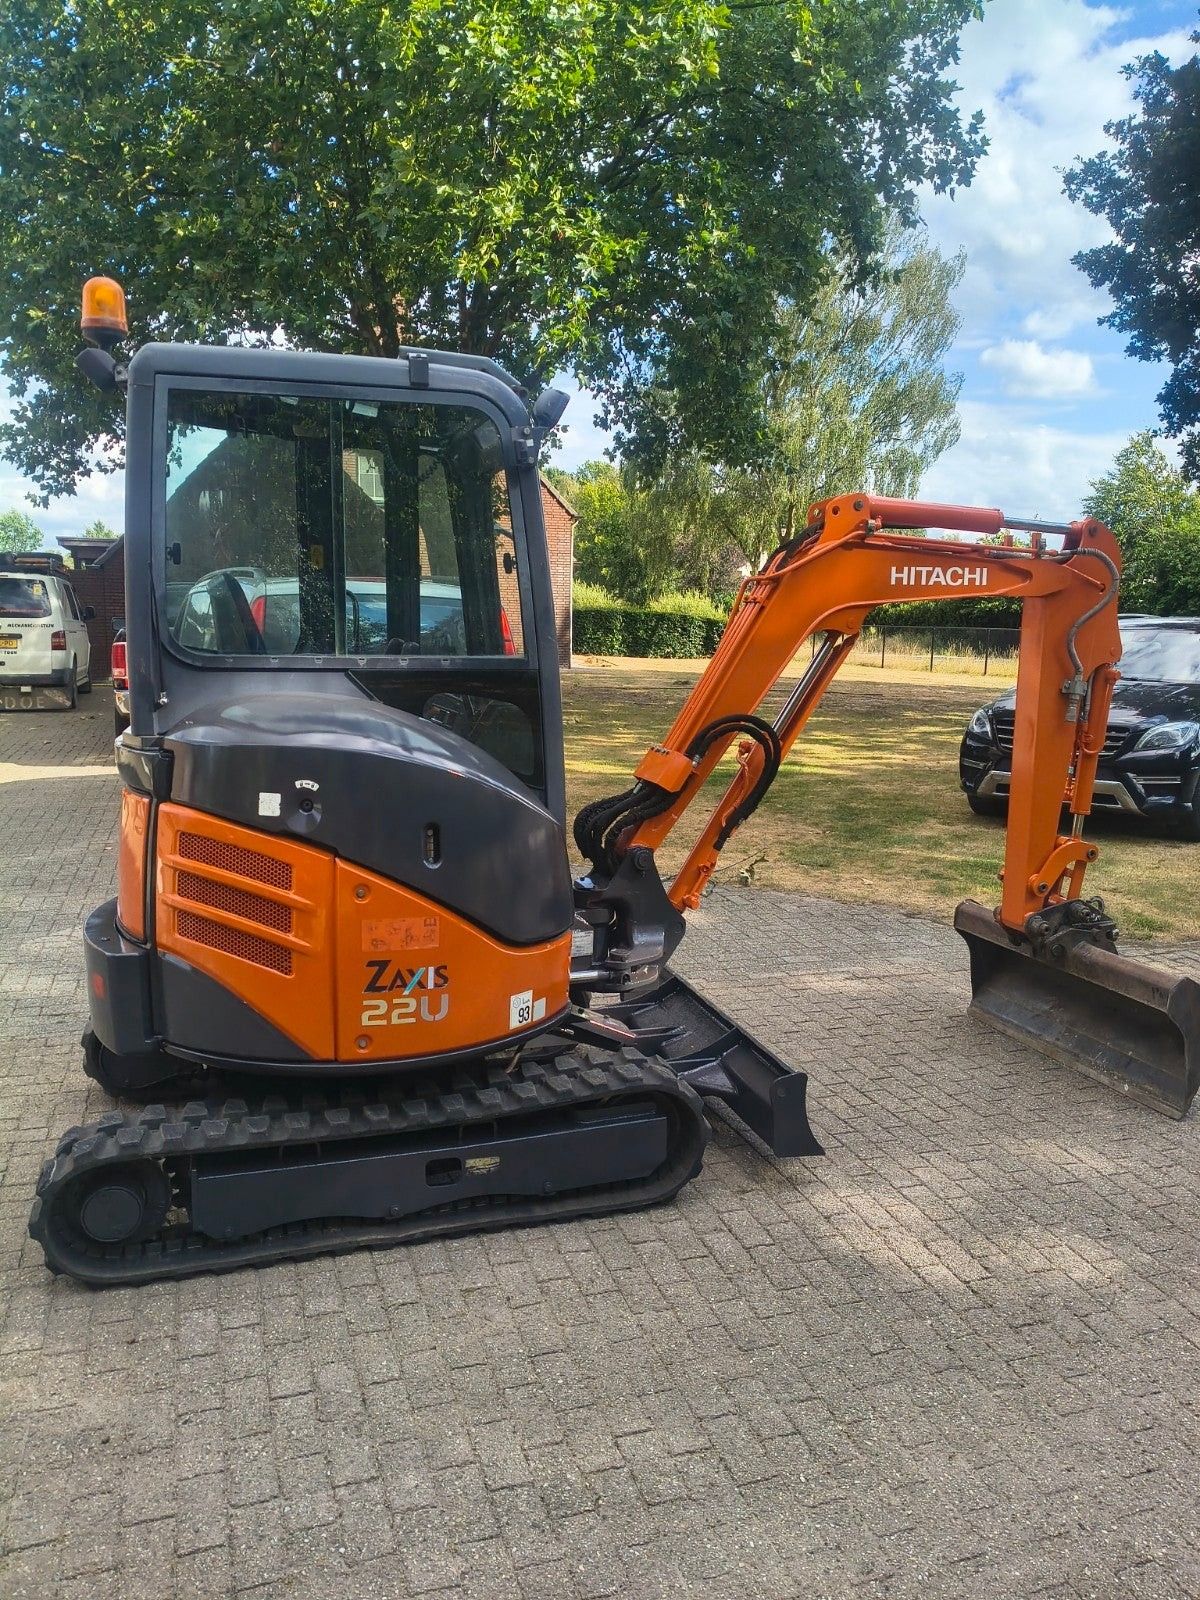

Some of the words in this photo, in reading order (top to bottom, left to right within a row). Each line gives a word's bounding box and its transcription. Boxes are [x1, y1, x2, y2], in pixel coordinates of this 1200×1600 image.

[890, 566, 988, 586] HITACHI
[362, 959, 449, 996] ZAXIS
[361, 993, 449, 1026] 22U
[518, 1005, 530, 1024] 93
